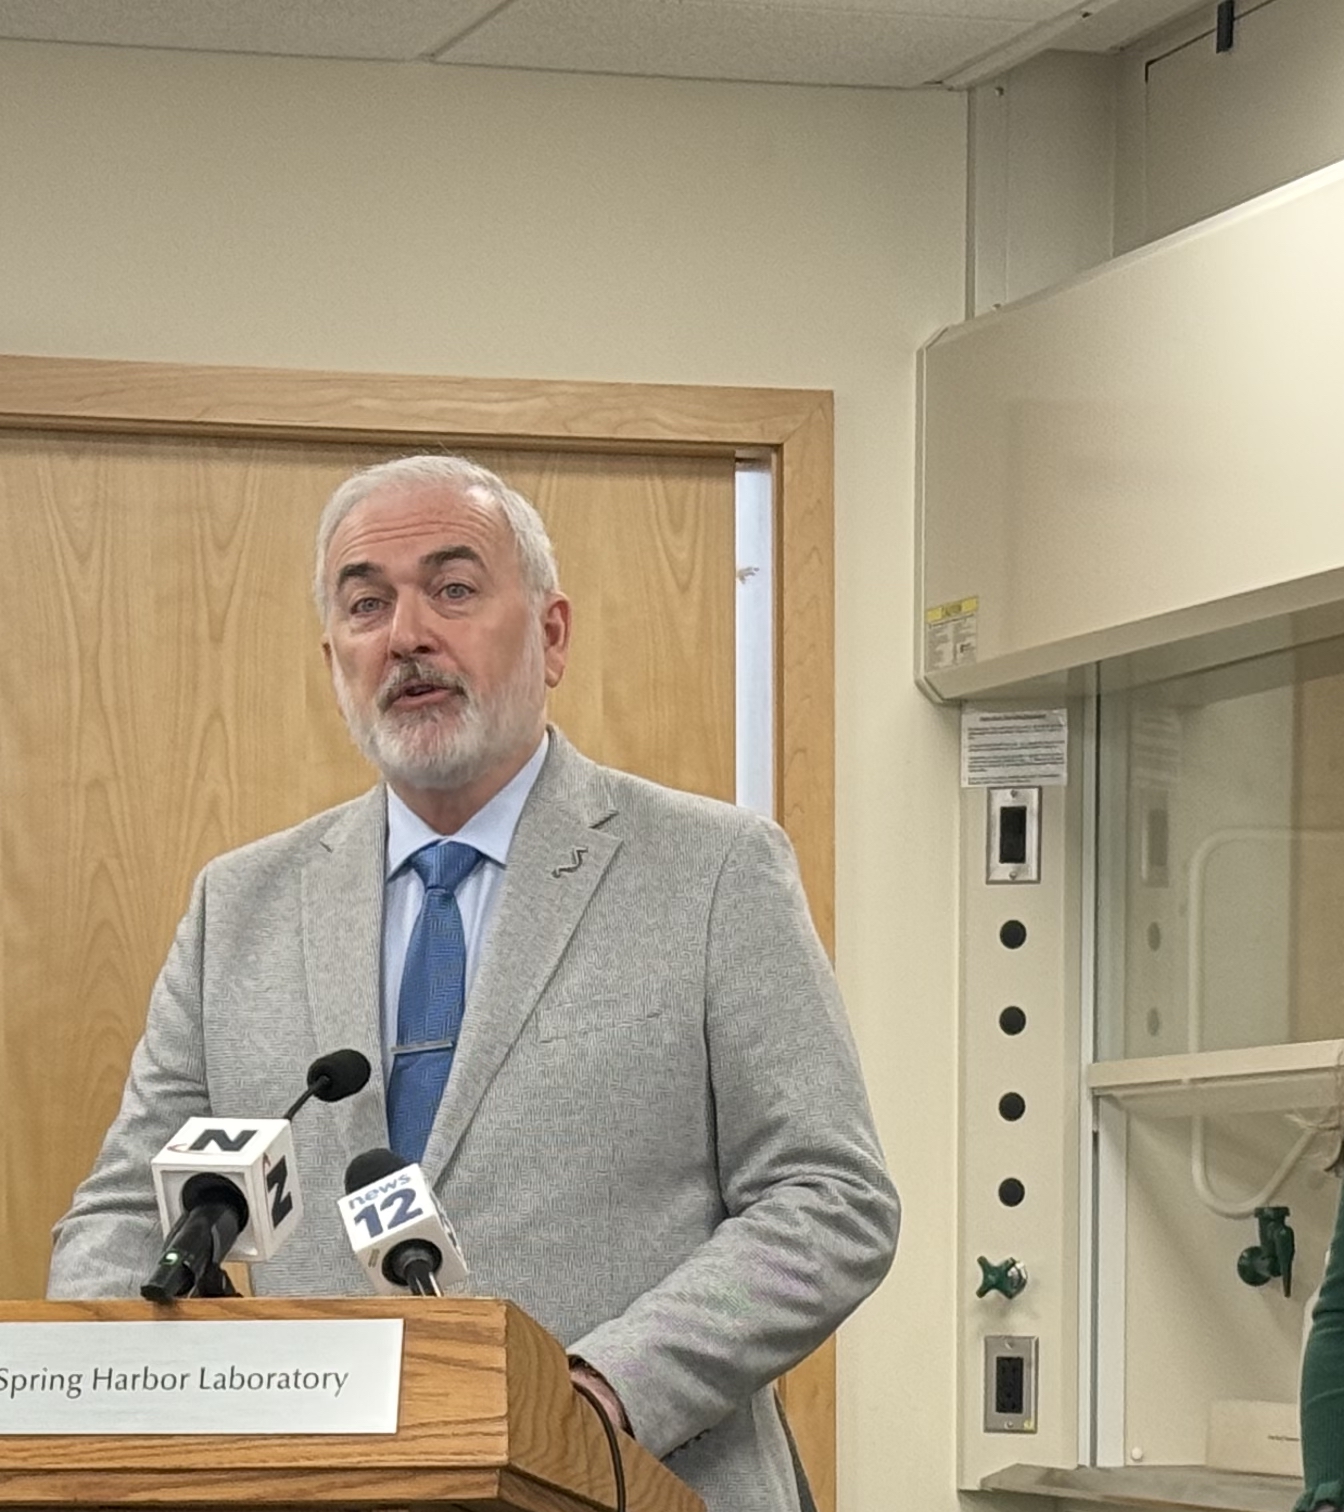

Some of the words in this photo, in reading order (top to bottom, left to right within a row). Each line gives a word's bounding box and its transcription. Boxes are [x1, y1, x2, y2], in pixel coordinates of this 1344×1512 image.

[348, 1173, 412, 1210] news
[353, 1188, 424, 1238] 12
[91, 1365, 191, 1392] Harbor
[199, 1365, 350, 1398] Laboratory
